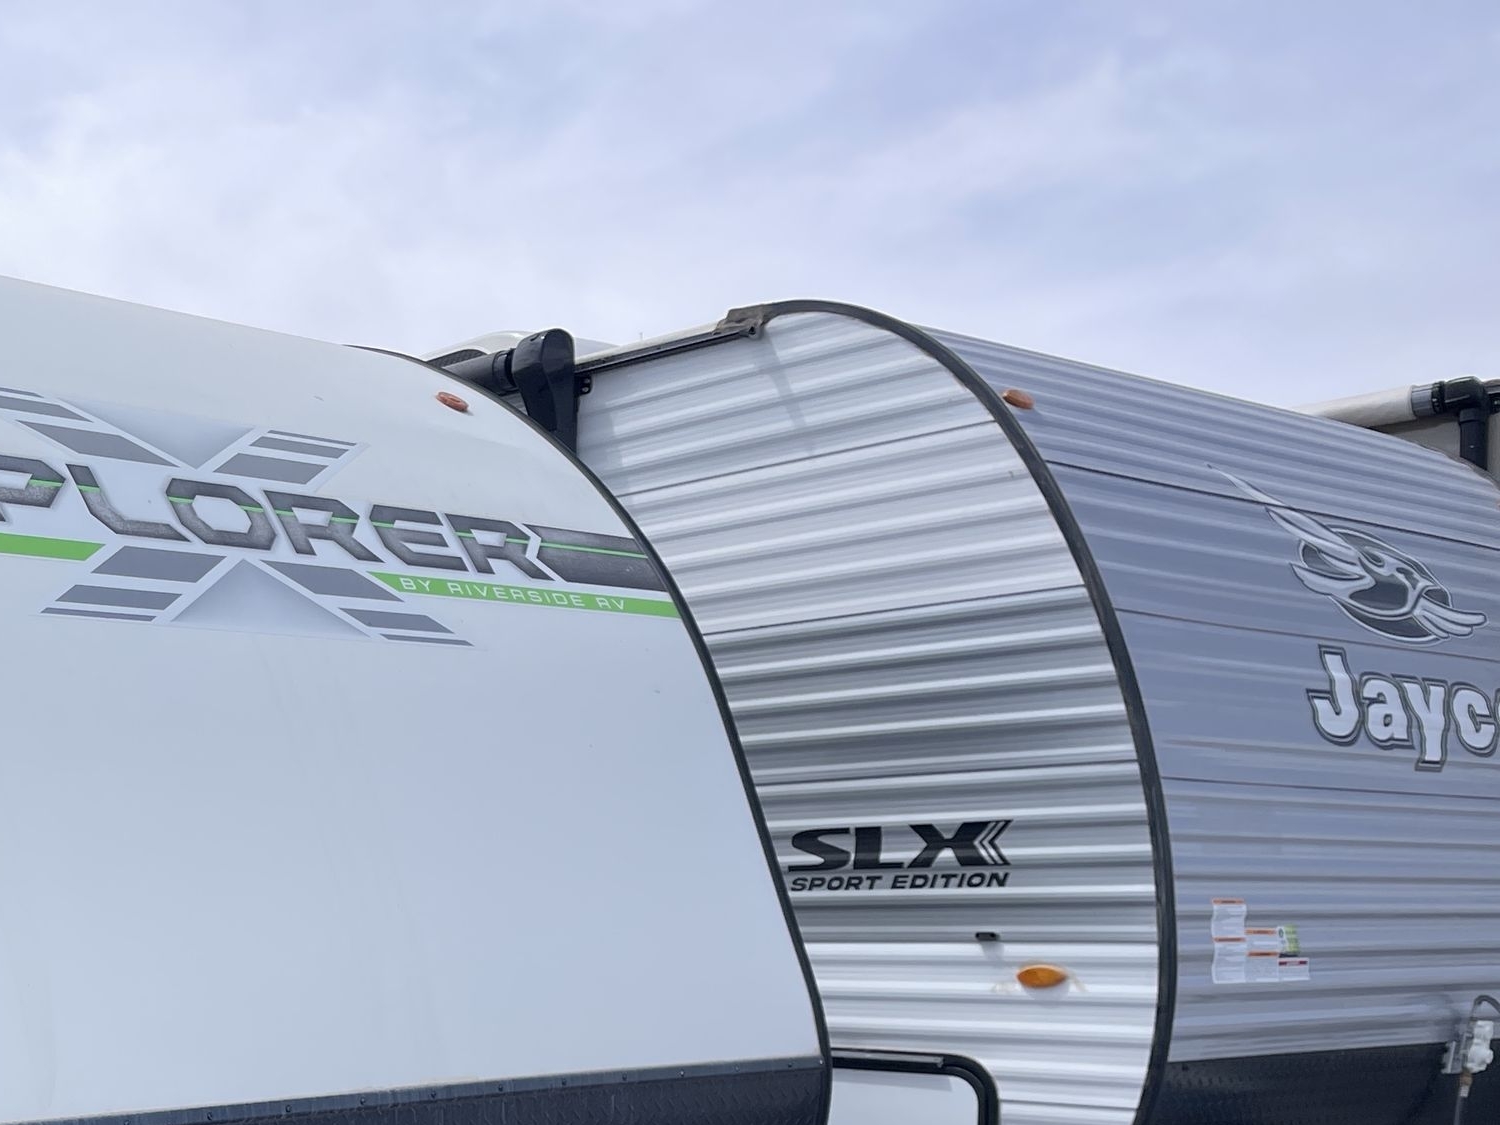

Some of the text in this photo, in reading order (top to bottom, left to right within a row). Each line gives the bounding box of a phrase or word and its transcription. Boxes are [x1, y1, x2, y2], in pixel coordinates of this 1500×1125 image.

[400, 577, 626, 611] BY RIVERSIDE RV
[1306, 644, 1500, 773] Jayc
[788, 819, 1013, 873] SLX
[790, 872, 1012, 892] SPORT EDITION
